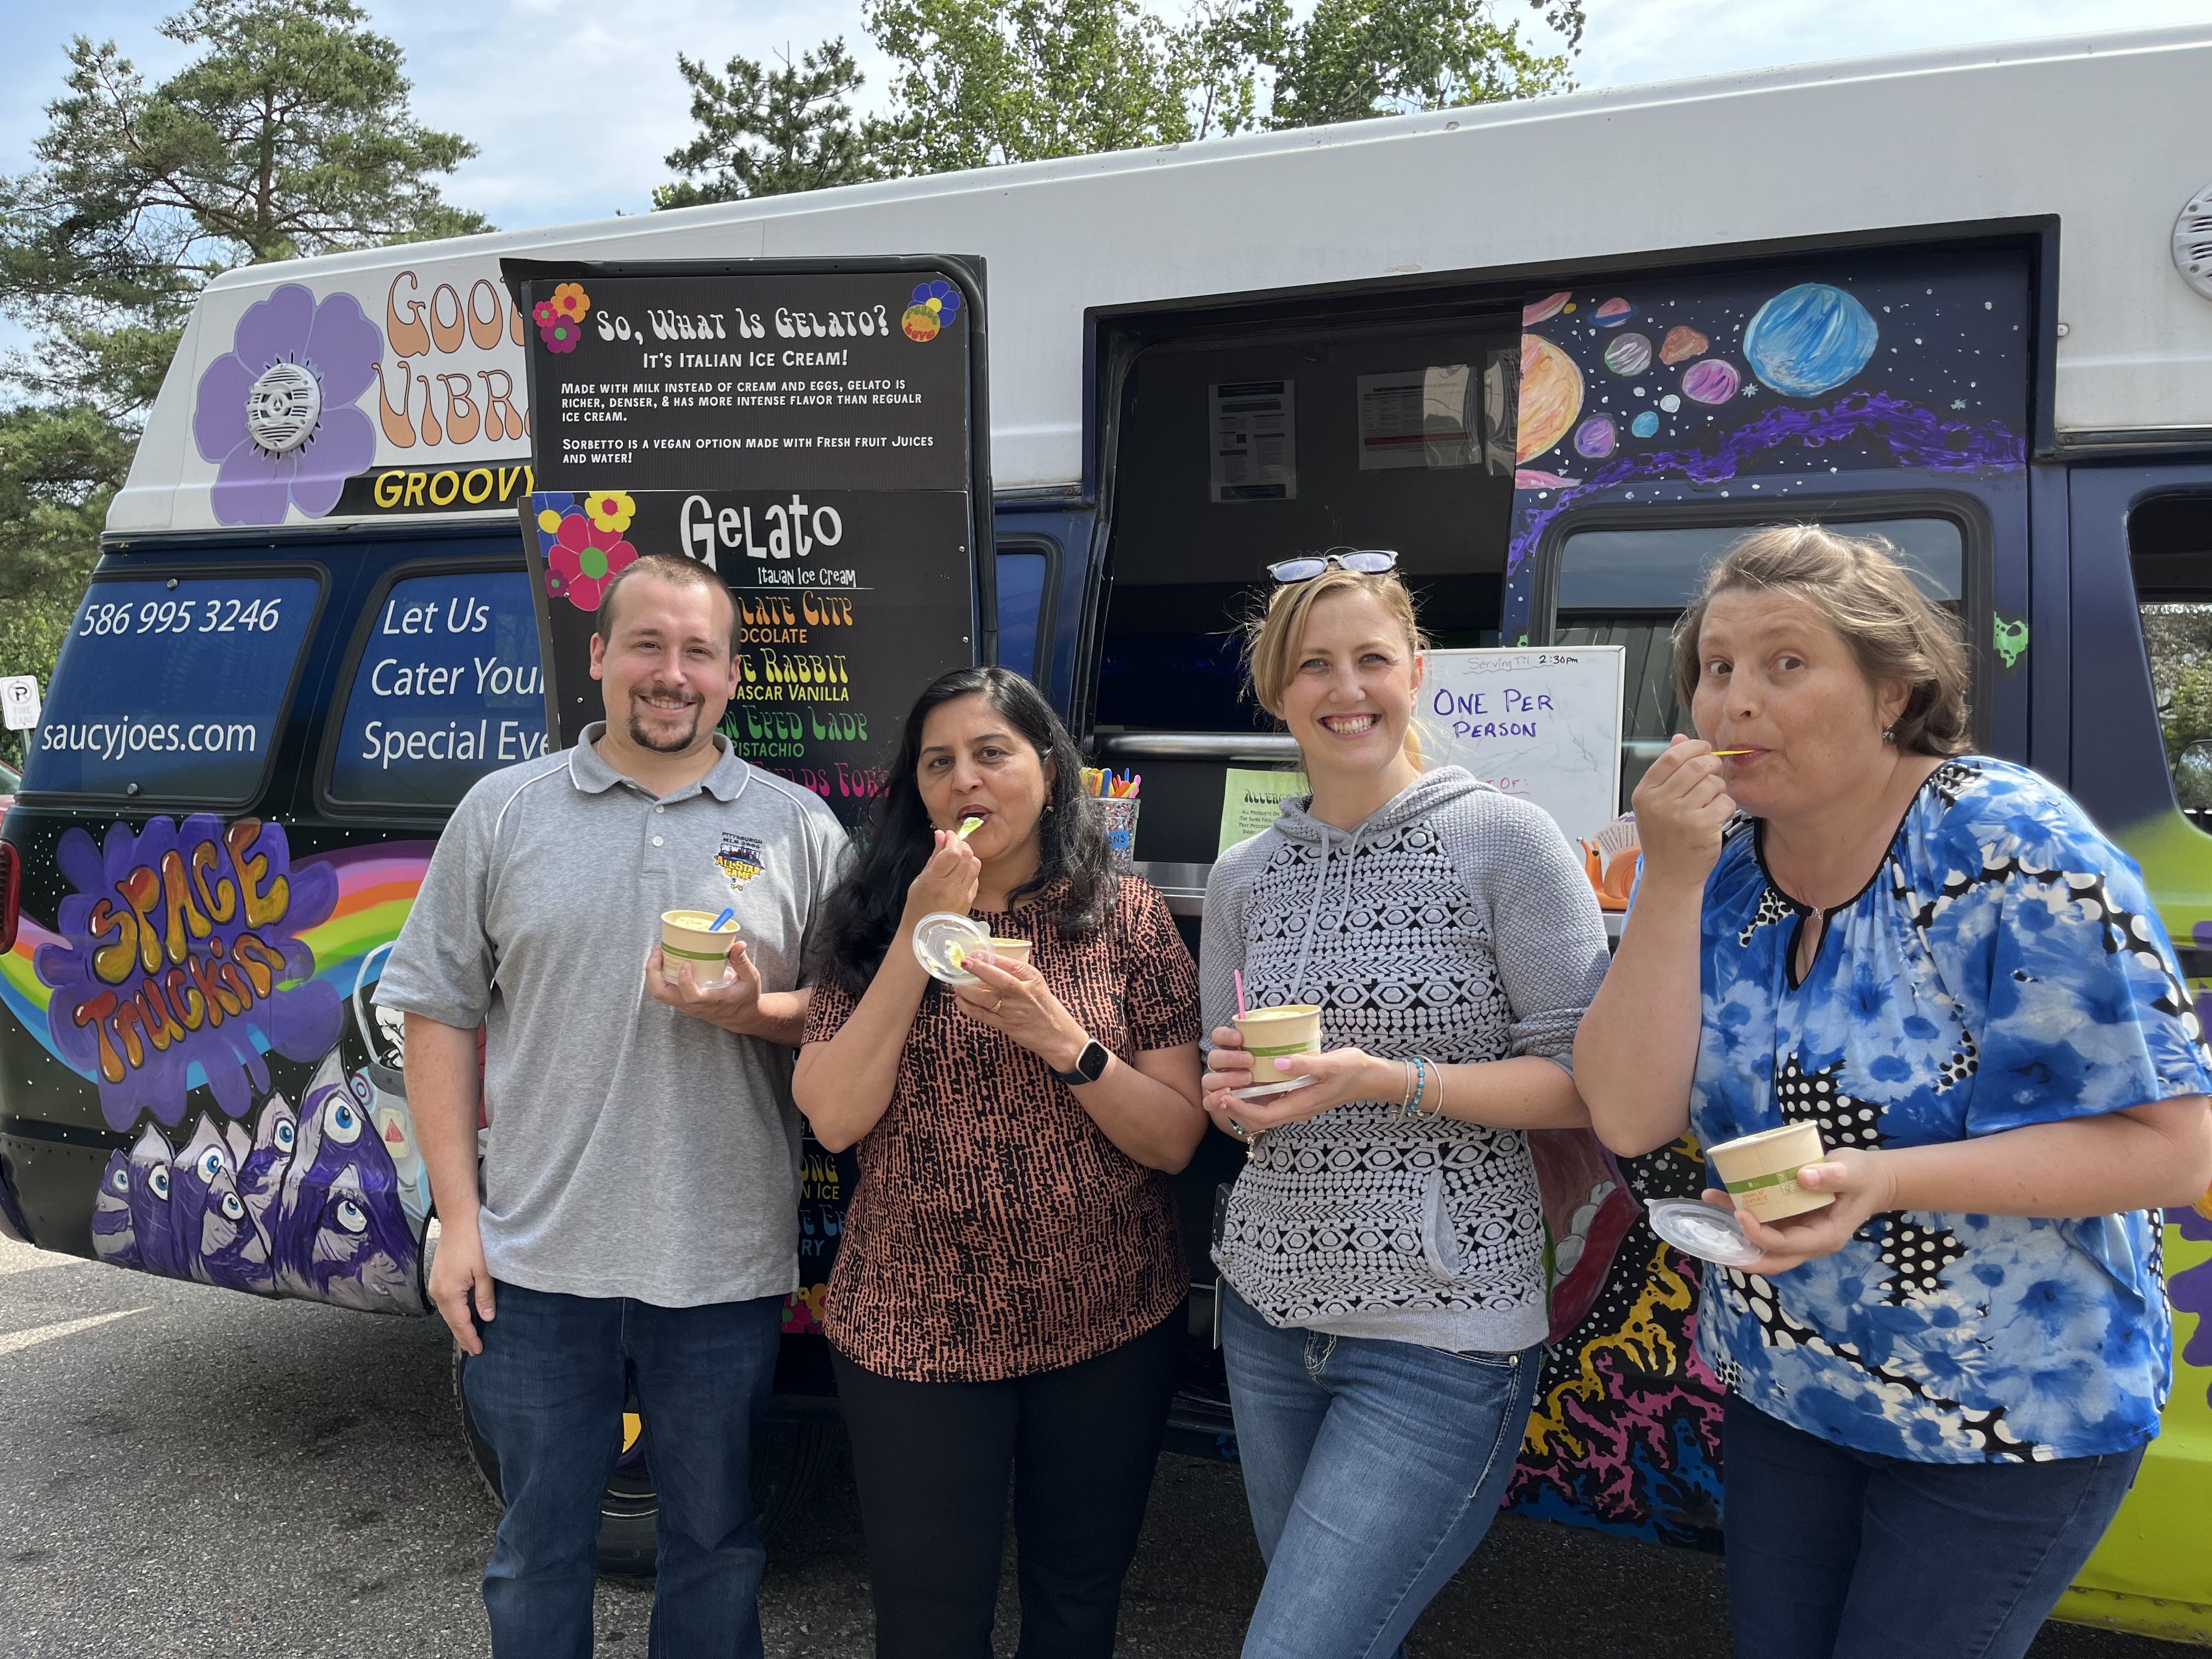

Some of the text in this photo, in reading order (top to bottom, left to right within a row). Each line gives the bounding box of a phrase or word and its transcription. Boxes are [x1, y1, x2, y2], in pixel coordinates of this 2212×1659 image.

[387, 272, 527, 357] GOO
[597, 305, 889, 345] SO, WHAT IS GELATO?
[644, 349, 847, 368] IT'S ITALIAN ICE CREAM!
[562, 380, 905, 393] MADE WITH MILK INSTEAD OF CREAM AND EGGS, GELATO IS
[371, 360, 531, 448] VIBR
[562, 394, 921, 409] RICHER, DENSER, & HAS MORE INTENSE FLAVOR THAN REGUALR
[563, 412, 627, 421] ICE CREAM.
[563, 436, 933, 449] SORBETTO IS A VEGAN OPTION MADE WITH FRESH FRUIT JUICES
[563, 452, 631, 463] AND WATER!
[79, 599, 281, 637] 586 995 3246
[383, 597, 489, 635] Let Us
[738, 596, 795, 625] LATE
[741, 628, 807, 643] OCOLATE
[372, 659, 464, 695] Cater
[760, 648, 849, 684] RABBIT
[729, 684, 849, 701] ASCAR VANILLA
[1434, 689, 1554, 715] ONE PER
[42, 715, 255, 760] saucyjoes.com
[1453, 721, 1536, 738] PERSON
[363, 719, 549, 769] Special Eve
[723, 832, 763, 844] PITTSBURGH
[725, 867, 752, 881] GAME
[89, 816, 289, 984] SPACE
[817, 1184, 839, 1199] ICE
